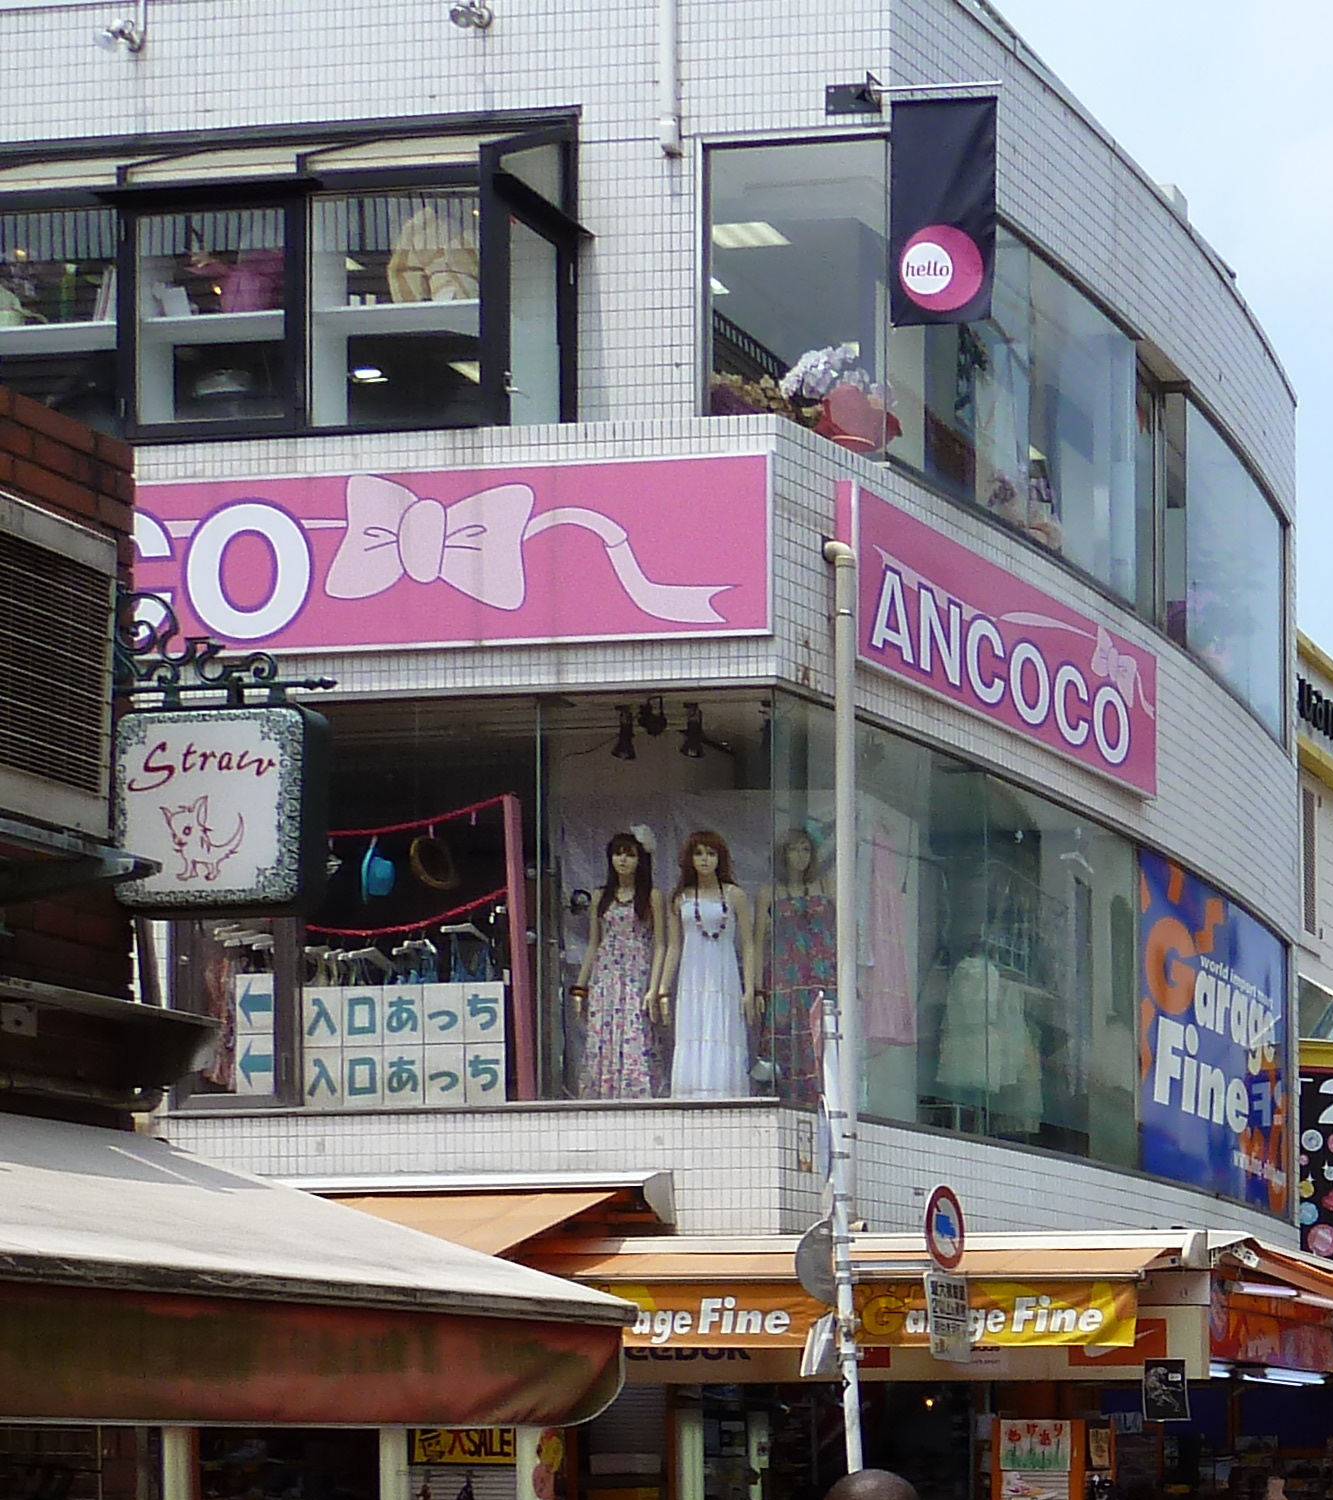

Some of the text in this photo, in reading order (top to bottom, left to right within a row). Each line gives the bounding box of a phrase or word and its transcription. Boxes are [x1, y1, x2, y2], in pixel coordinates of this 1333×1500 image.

[904, 259, 951, 278] hello
[869, 563, 1132, 769] ANCOCO
[128, 741, 276, 793] Straw
[306, 993, 499, 1038] 入口あっち
[1145, 917, 1276, 1075] Garage
[306, 1054, 499, 1098] 入口あっち
[1153, 1015, 1249, 1134] Fine
[697, 1296, 791, 1335] Fine
[1010, 1295, 1104, 1334] Fine
